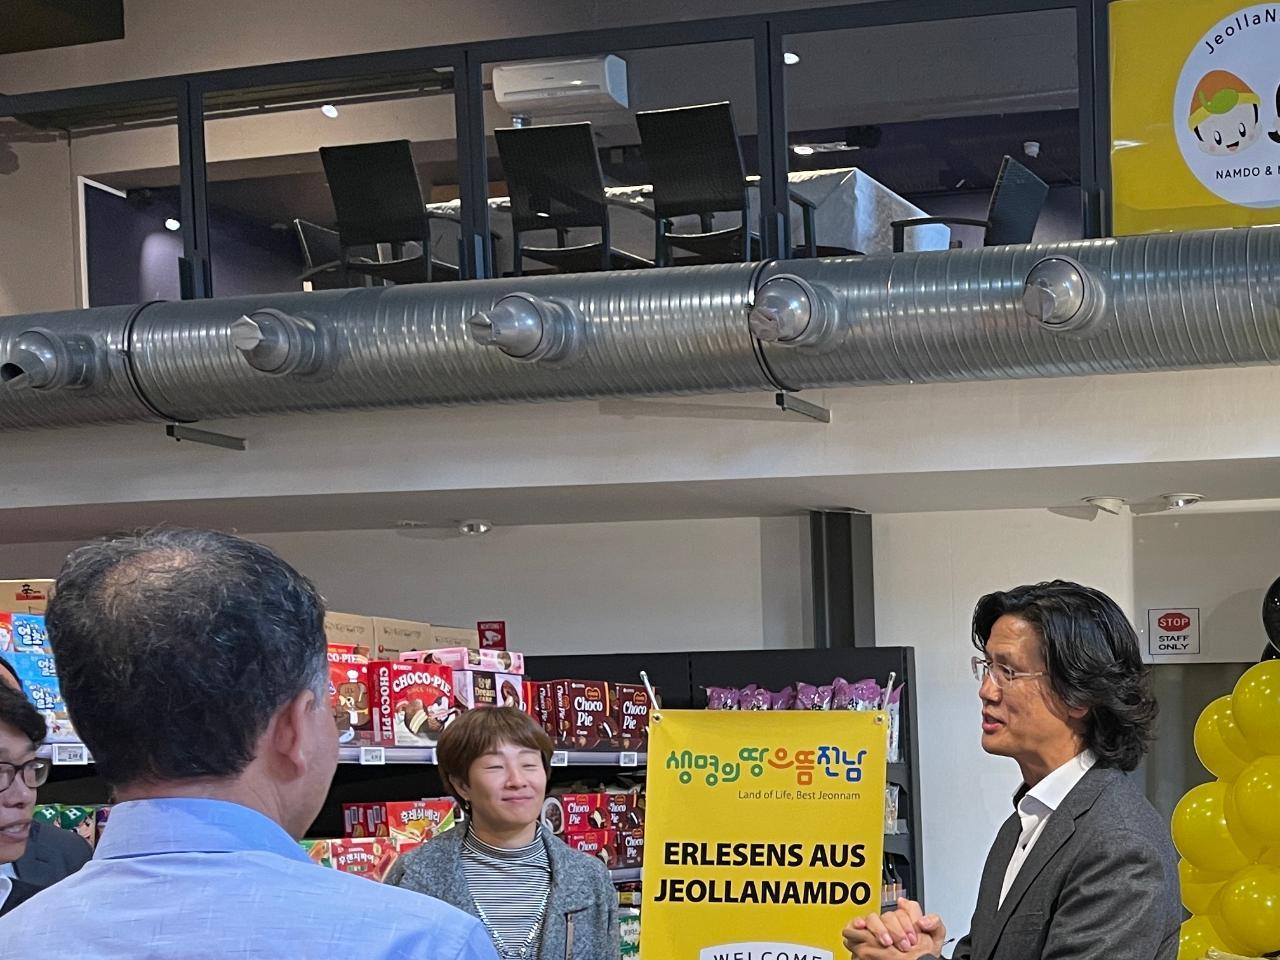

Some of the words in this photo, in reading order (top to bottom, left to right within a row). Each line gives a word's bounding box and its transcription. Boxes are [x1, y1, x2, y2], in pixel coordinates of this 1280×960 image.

[1215, 167, 1261, 181] NAMDO
[1264, 165, 1274, 178] &
[1159, 618, 1189, 627] STOP
[1158, 635, 1190, 643] STAFF
[1158, 643, 1190, 651] ONLY
[474, 687, 496, 697] Dream
[574, 696, 603, 711] Choco
[622, 701, 647, 716] Choco
[576, 712, 593, 727] Pie
[623, 716, 637, 730] Pie
[738, 789, 761, 801] Land
[763, 789, 774, 801] of
[775, 789, 795, 802] Life,
[796, 789, 816, 801] Best
[817, 790, 861, 801] Jeonnam
[65, 807, 82, 820] H
[567, 802, 590, 814] Choco
[400, 808, 441, 824] 후레쉬베리
[568, 813, 581, 825] Pie
[577, 840, 598, 851] Choco
[625, 836, 643, 847] Choco
[626, 847, 638, 858] Pie
[663, 842, 803, 868] ERLESENS
[809, 843, 866, 869] AUS
[653, 878, 871, 906] JEOLLANAMDO
